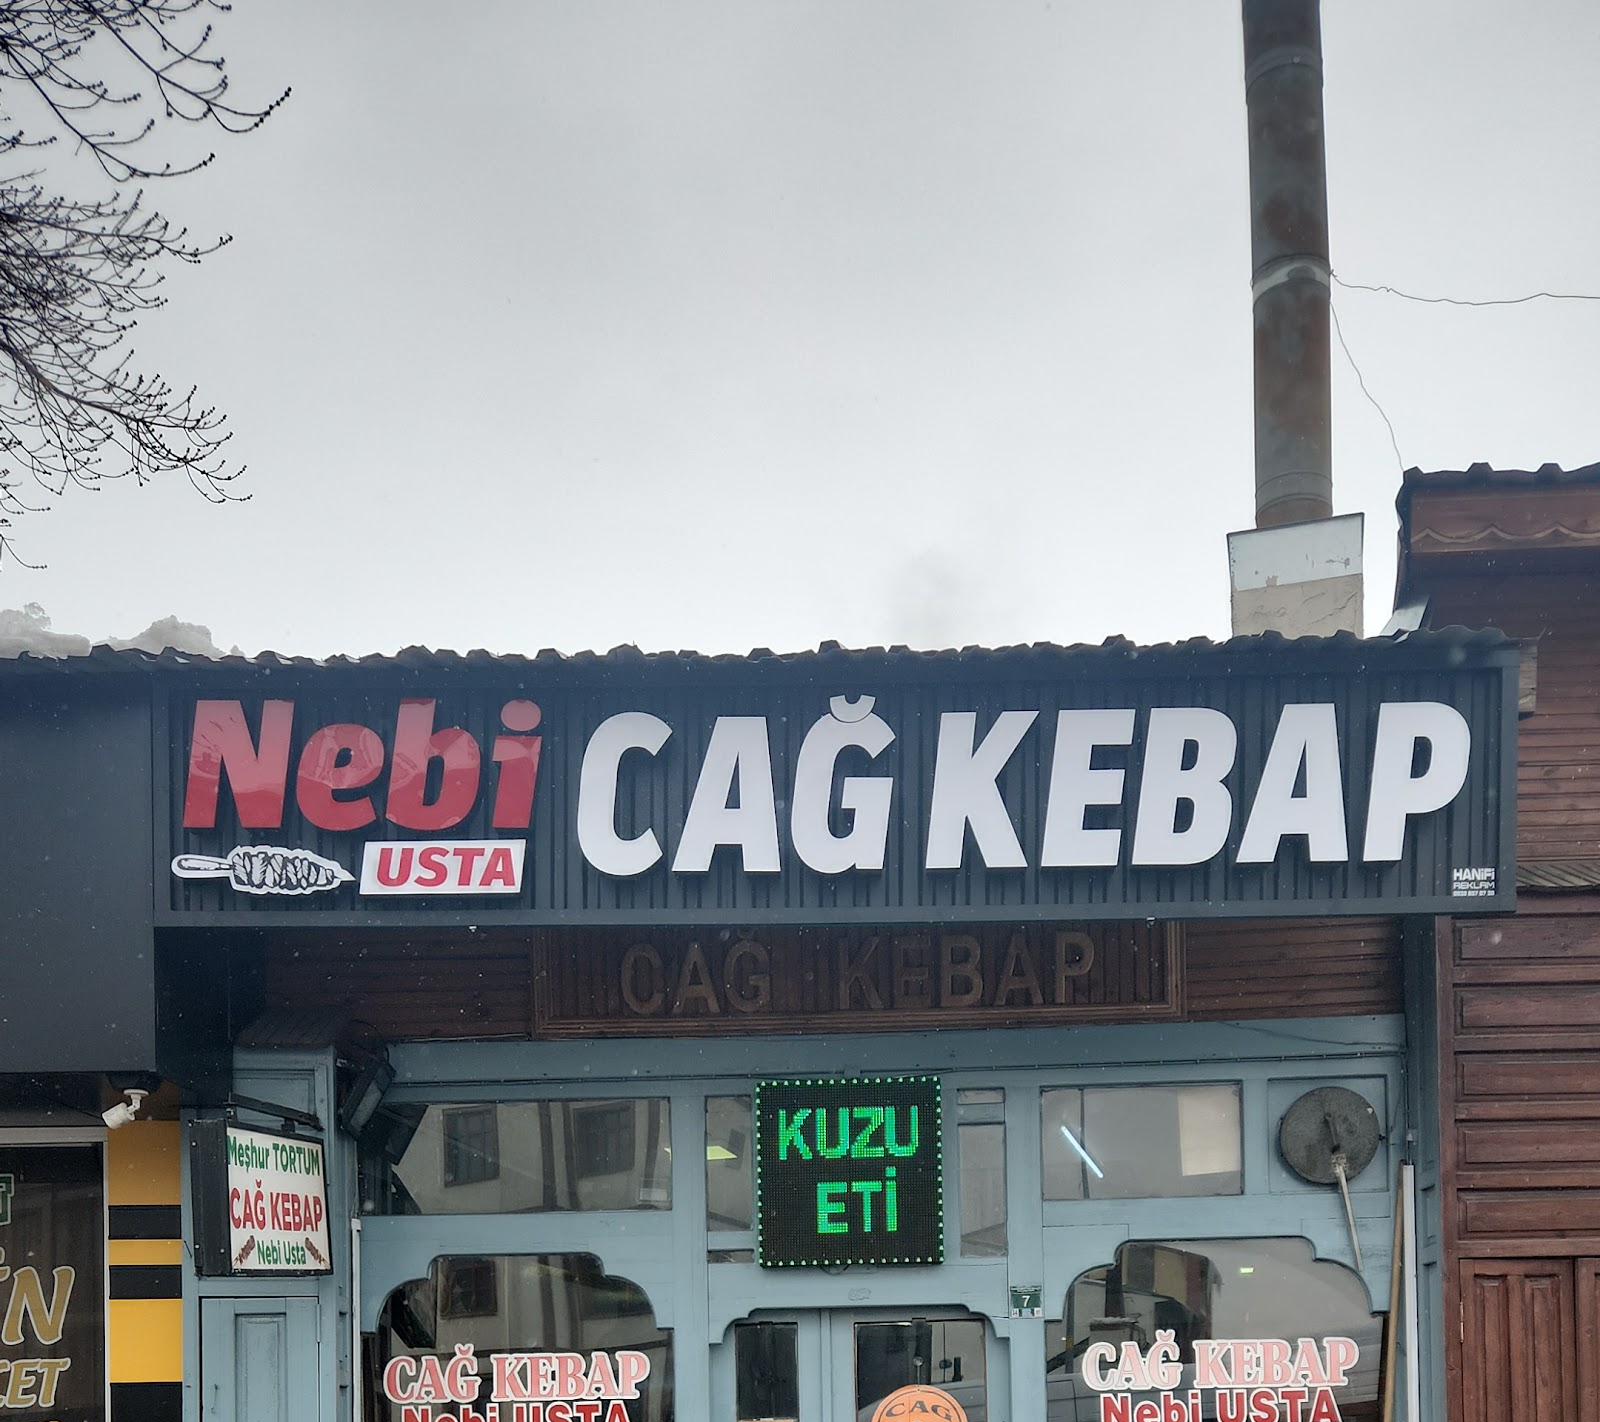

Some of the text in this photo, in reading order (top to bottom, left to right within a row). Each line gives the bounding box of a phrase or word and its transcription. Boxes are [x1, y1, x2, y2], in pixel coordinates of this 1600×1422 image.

[183, 698, 542, 831] Nebi
[577, 695, 1472, 876] CAĞ KEBAP
[376, 846, 517, 888] USTA
[1453, 881, 1495, 890] REKLAM
[838, 931, 1096, 1010] KEBAP
[227, 1135, 320, 1176] Meşhur TORTUM
[778, 1105, 919, 1160] KUZU
[230, 1178, 323, 1232] CAĞ KEBAP
[817, 1165, 898, 1233] ETİ
[256, 1239, 307, 1266] Nebi Usta
[1021, 1295, 1031, 1307] 7
[384, 1343, 650, 1403] CAĞ KEBAP
[1082, 1329, 1359, 1391] CAĞ KEBAP
